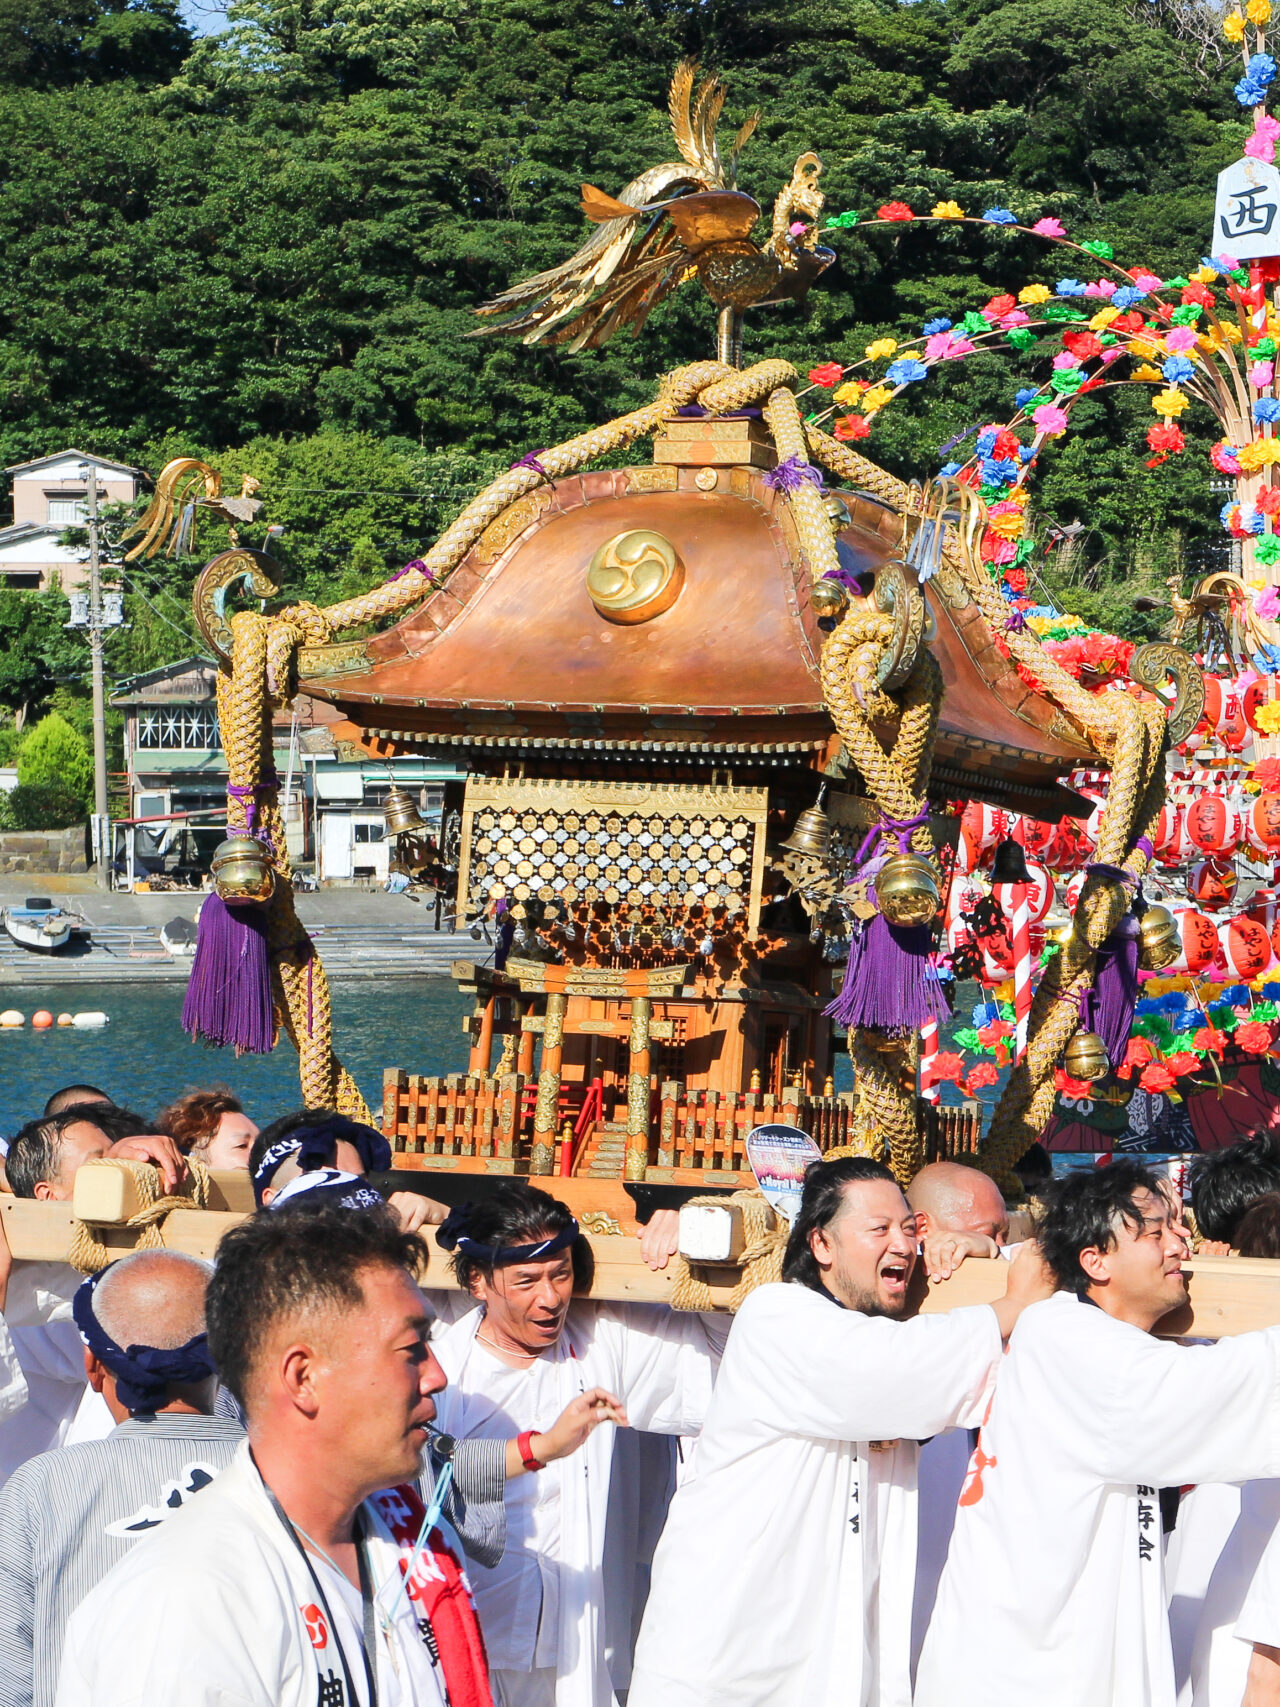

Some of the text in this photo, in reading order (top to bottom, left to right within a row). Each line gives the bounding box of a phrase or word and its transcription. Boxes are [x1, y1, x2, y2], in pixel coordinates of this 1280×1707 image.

[1220, 185, 1277, 239] 西
[1196, 804, 1216, 843] はやし連
[1194, 920, 1215, 962] はやし連
[1239, 926, 1265, 969] はやし連
